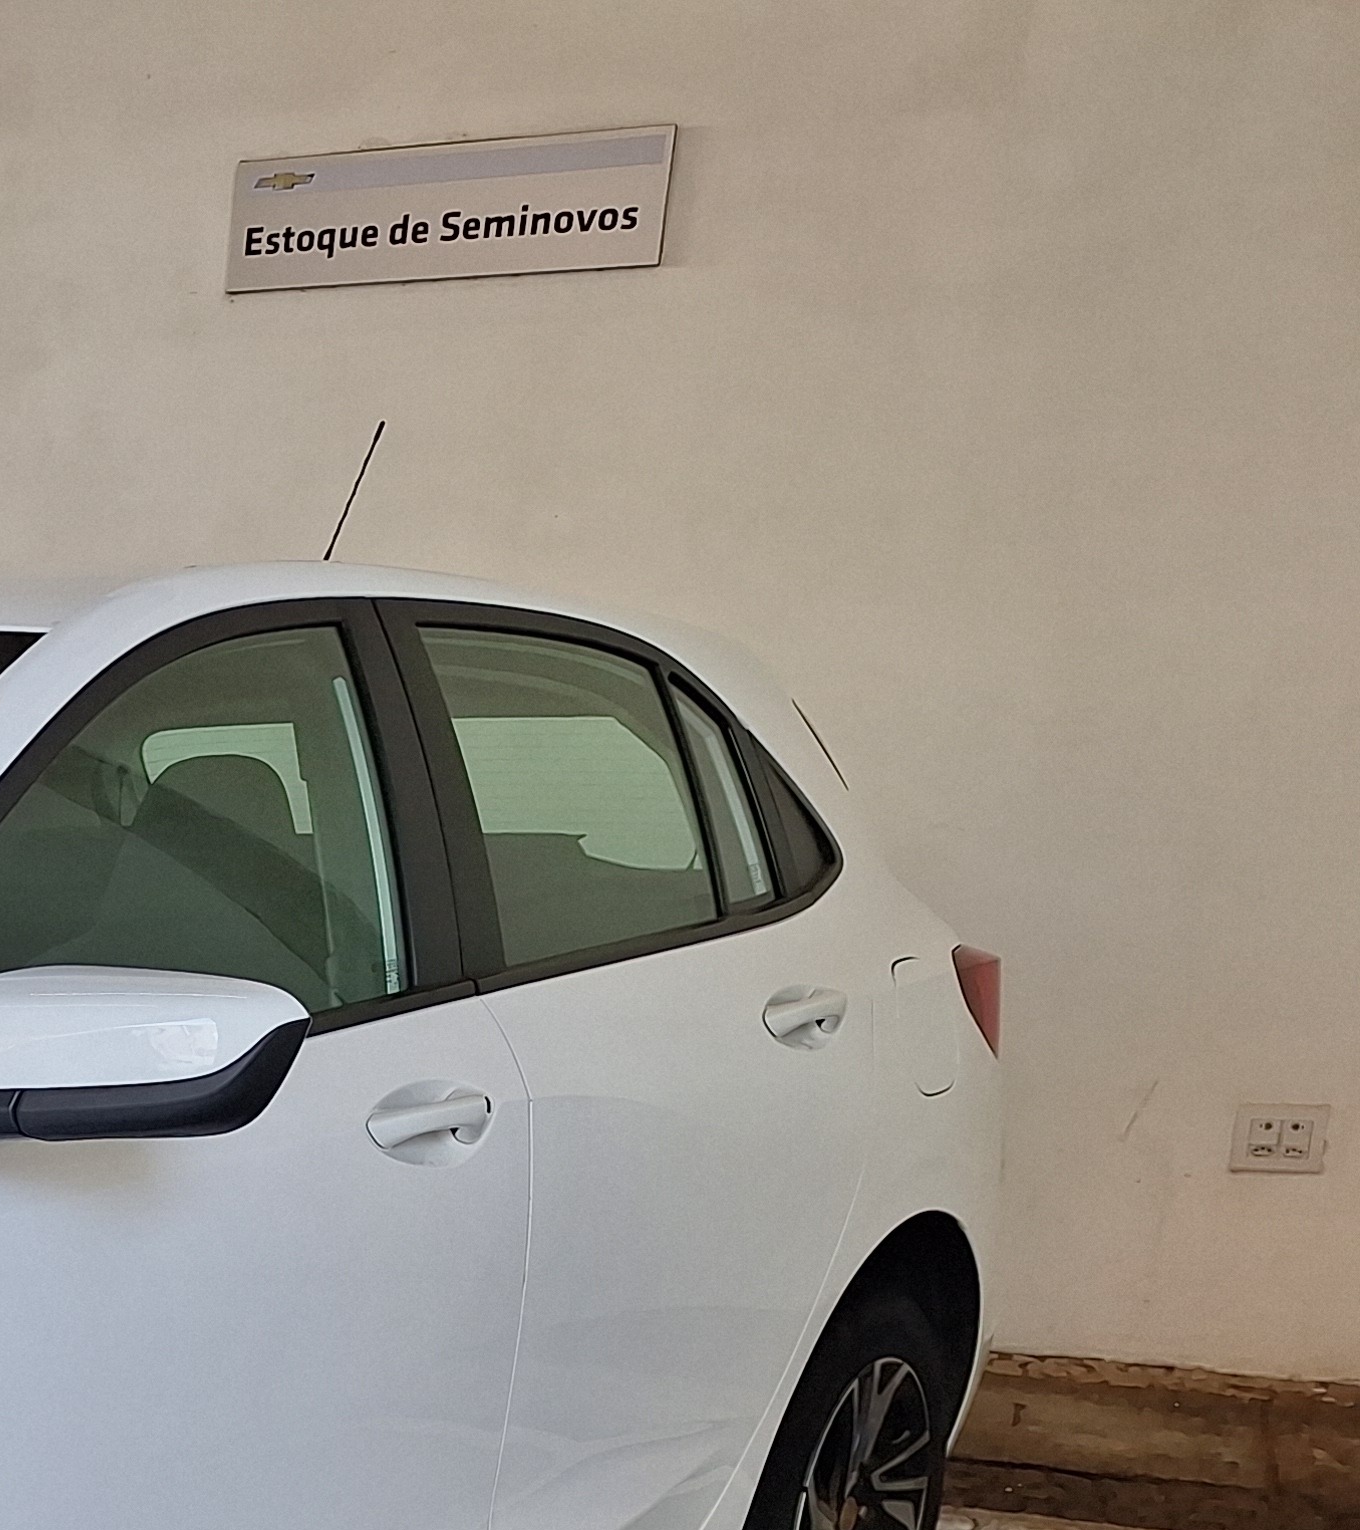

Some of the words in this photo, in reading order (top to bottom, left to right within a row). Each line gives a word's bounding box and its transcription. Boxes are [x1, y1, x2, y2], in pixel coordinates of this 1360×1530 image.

[244, 225, 378, 258] Estoque
[388, 214, 429, 246] de
[439, 204, 638, 243] Seminovos
